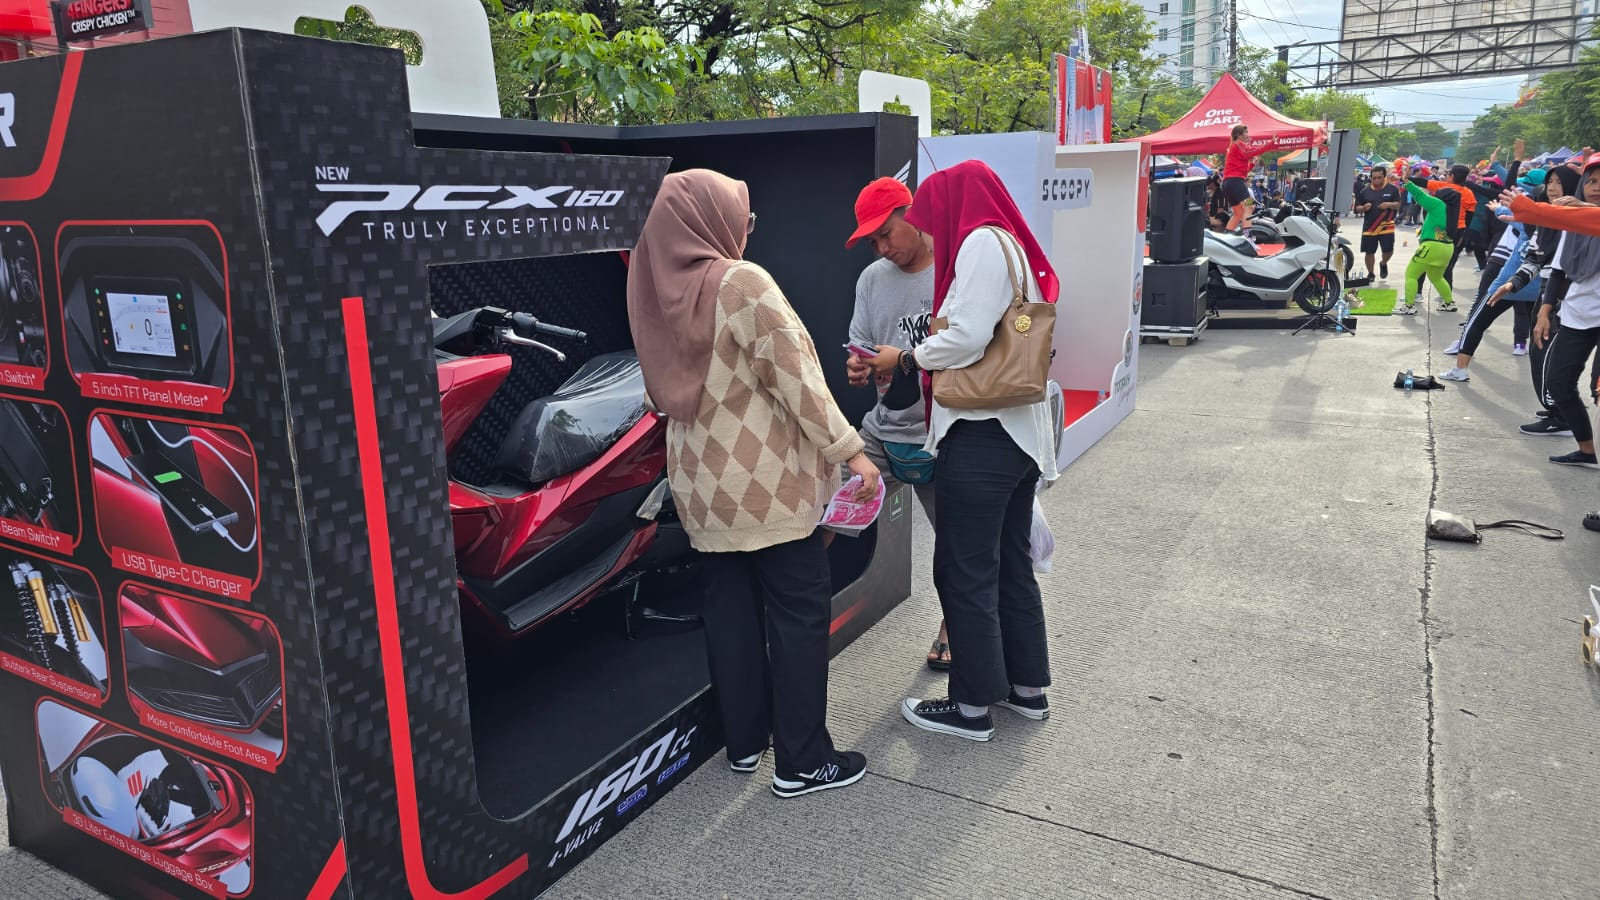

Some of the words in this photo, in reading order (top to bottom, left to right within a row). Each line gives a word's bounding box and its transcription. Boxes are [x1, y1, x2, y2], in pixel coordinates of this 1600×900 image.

[71, 18, 95, 33] CRISPY
[1205, 108, 1234, 118] One
[1279, 136, 1308, 145] MOTOR
[315, 166, 349, 180] NEW
[1042, 178, 1090, 201] SCOOPY
[315, 184, 573, 237] PCX
[564, 190, 625, 207] 160
[363, 220, 448, 240] TRULY
[466, 215, 611, 237] EXCEPTIONAL
[92, 382, 99, 394] 5
[100, 382, 121, 398] inch
[122, 385, 141, 399] TFT
[143, 388, 172, 404] Panel
[1, 520, 27, 538] Beam
[122, 552, 147, 571] USB
[147, 558, 190, 580] Type-C
[192, 569, 242, 595] Charger
[147, 713, 168, 729] More
[169, 721, 222, 749] Comfortable
[224, 740, 243, 757] Foot
[245, 748, 268, 764] Area
[555, 727, 678, 844] 160
[72, 813, 82, 827] 30
[84, 819, 101, 836] Liter
[103, 828, 126, 848] Extra
[126, 839, 152, 862] Large
[152, 850, 193, 882] Luggage
[195, 873, 214, 891] Box
[547, 816, 604, 868] 4-VALVE
